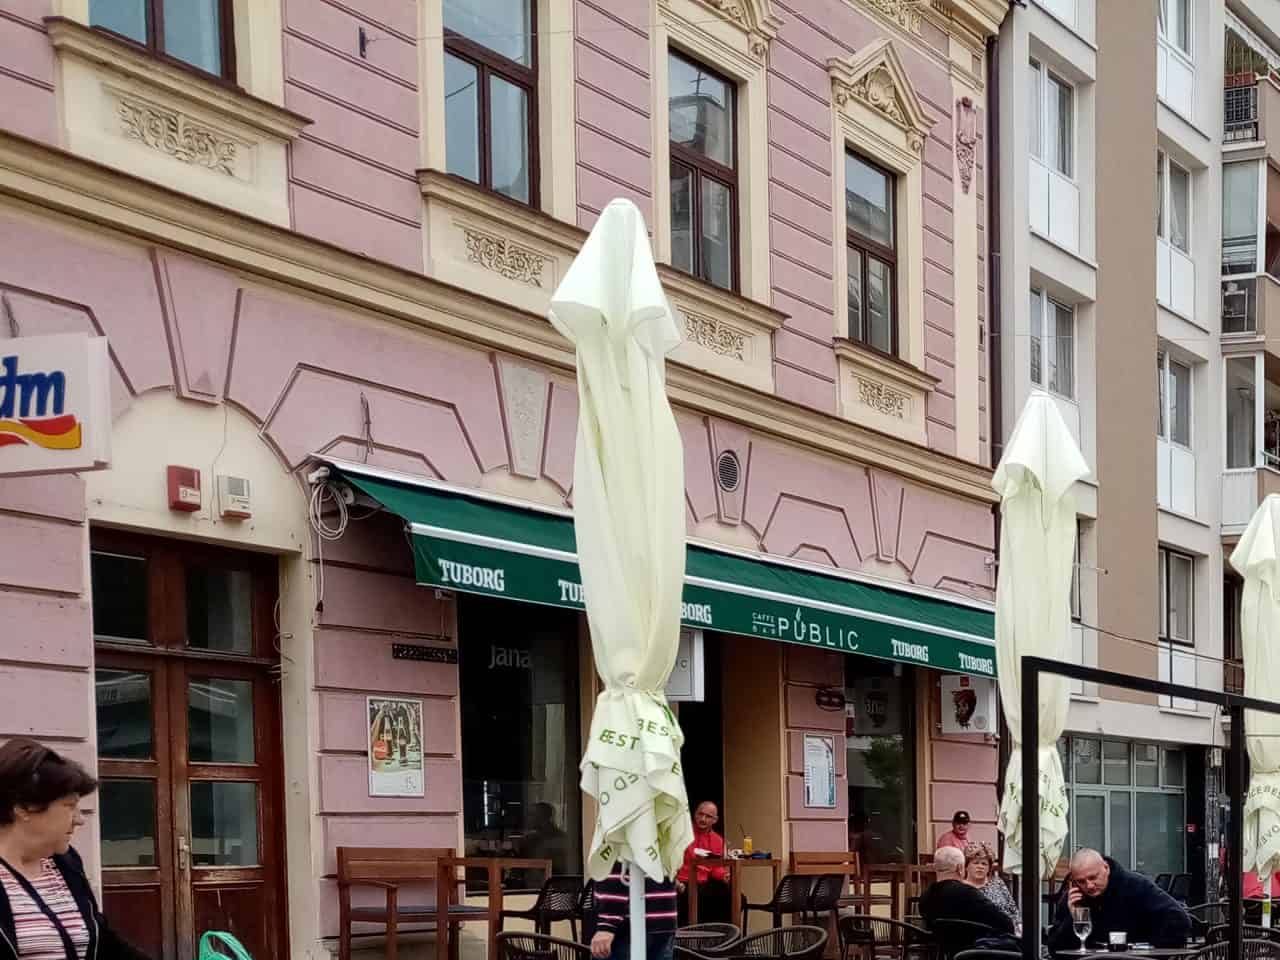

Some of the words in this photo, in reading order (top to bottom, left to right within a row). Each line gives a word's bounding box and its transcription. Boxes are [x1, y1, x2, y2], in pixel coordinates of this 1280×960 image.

[438, 558, 505, 592] TUBORG
[778, 616, 859, 650] PUBLIC
[891, 638, 929, 662] TUBORG
[958, 652, 993, 675] TUBORG
[599, 728, 641, 751] BEST
